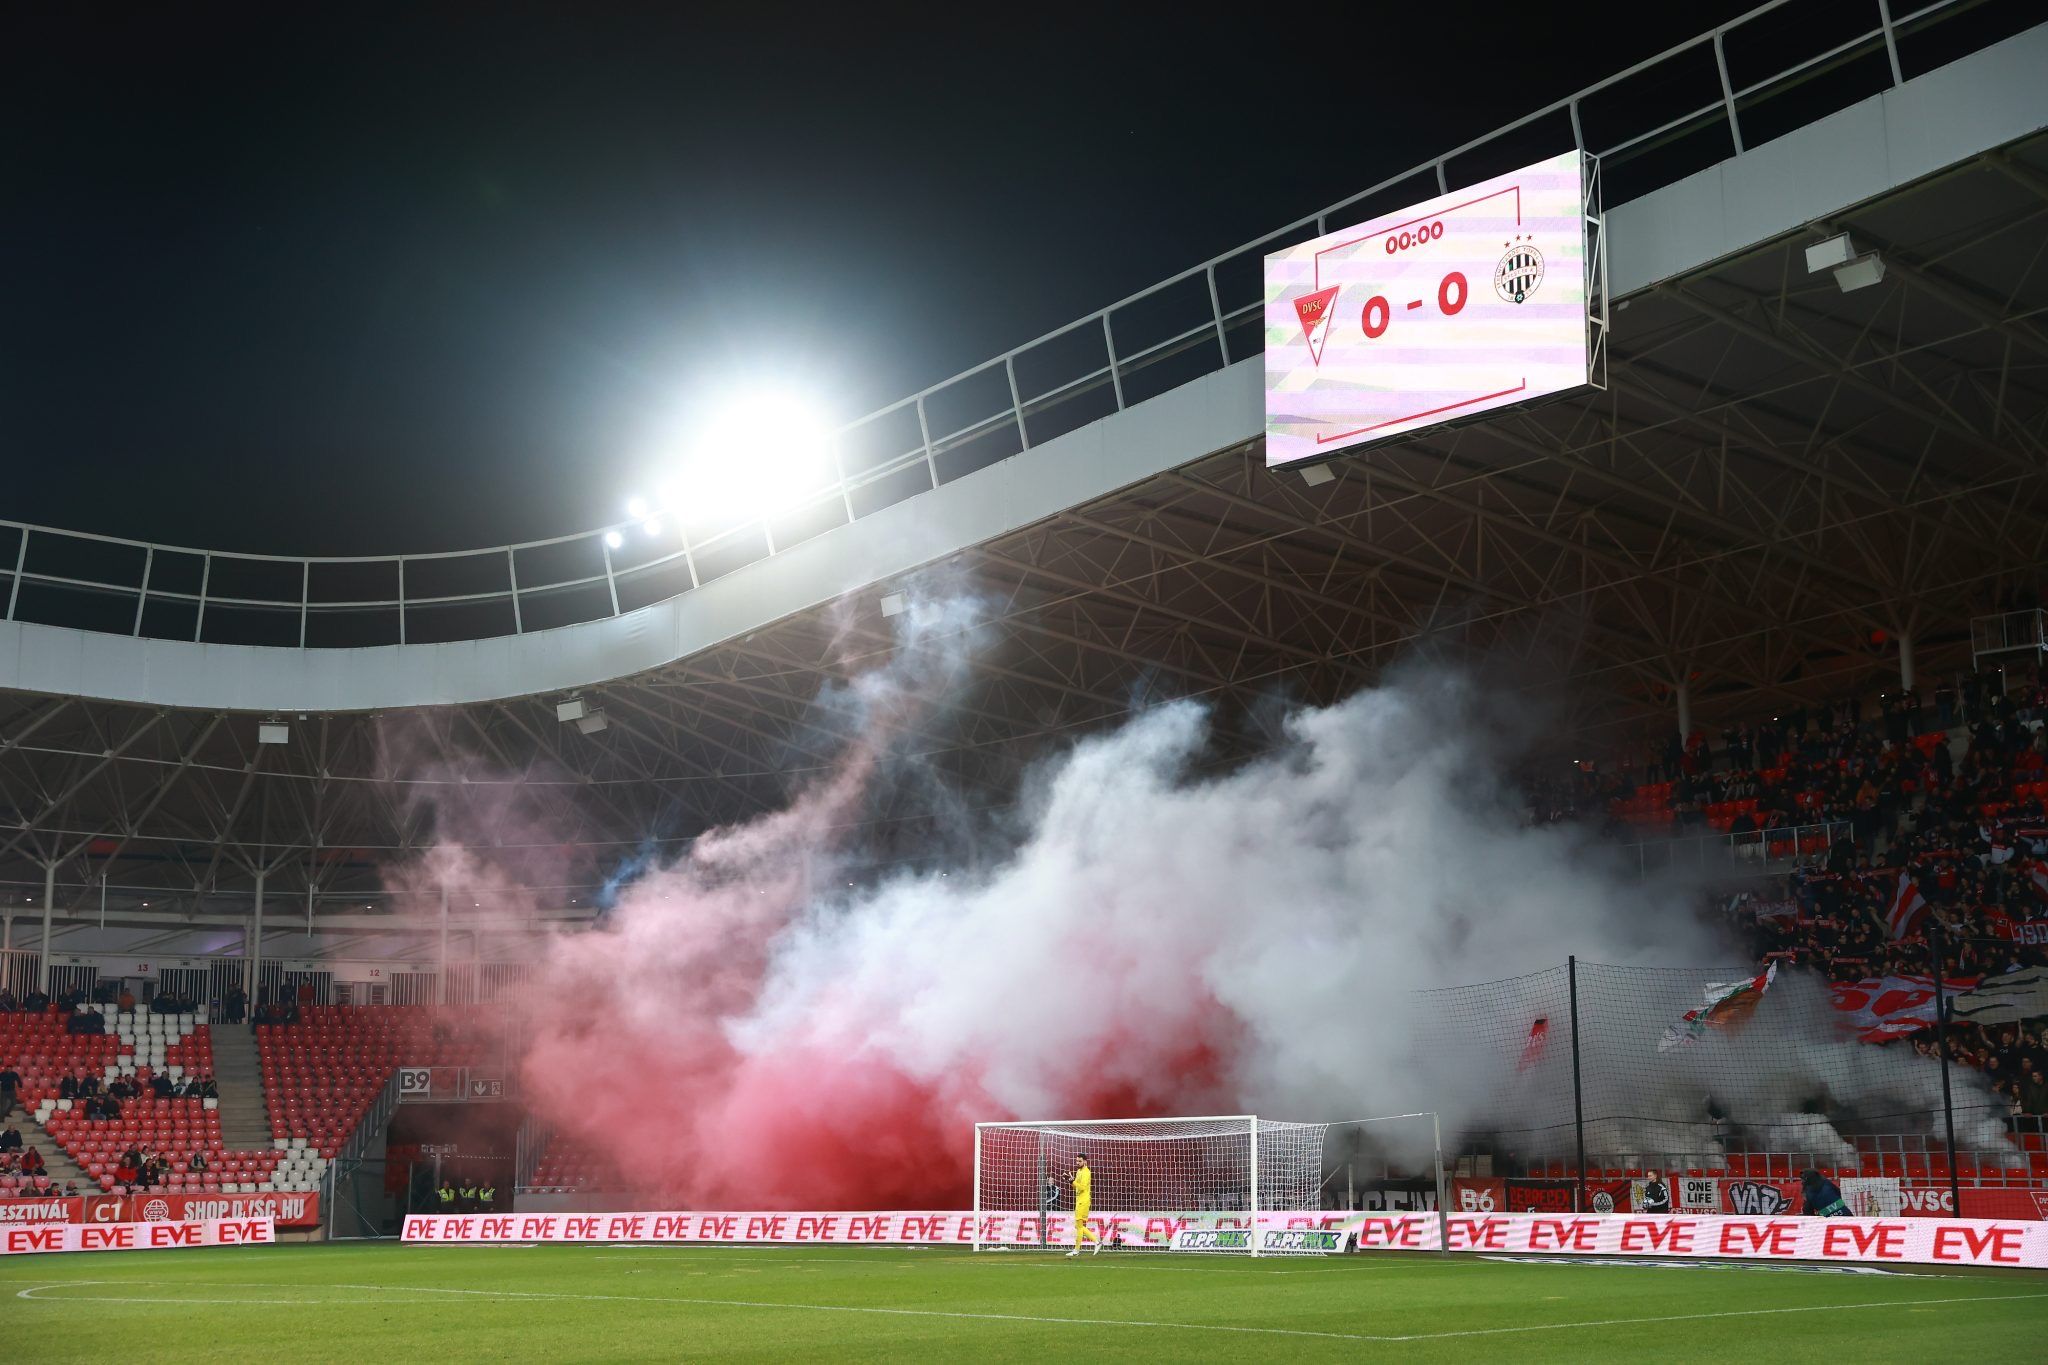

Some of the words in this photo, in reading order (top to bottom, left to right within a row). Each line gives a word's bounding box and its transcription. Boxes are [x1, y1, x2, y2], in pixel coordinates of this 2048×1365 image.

[1386, 221, 1443, 254] 00:00
[1302, 299, 1322, 314] DVSC
[1362, 296, 1390, 338] 0
[1407, 299, 1423, 311] -
[1438, 271, 1468, 316] 0
[138, 964, 149, 972] 13
[370, 969, 380, 977] 12
[400, 1071, 430, 1090] B9
[1687, 1182, 1712, 1192] ONE
[1461, 1188, 1494, 1212] B6
[1687, 1193, 1712, 1203] LIFE
[95, 1203, 122, 1221] C1
[7, 1228, 64, 1252] EVE
[80, 1226, 134, 1249] EVE
[150, 1223, 202, 1247] EVE
[217, 1221, 267, 1243] EVE
[406, 1218, 436, 1240] EVE
[443, 1217, 474, 1240] EVE
[480, 1217, 514, 1240] EVE
[521, 1217, 556, 1240] EVE
[564, 1217, 601, 1240] EVE
[608, 1216, 645, 1240] EVE
[653, 1216, 690, 1239] EVE
[698, 1216, 737, 1239] EVE
[746, 1216, 786, 1240] EVE
[796, 1216, 838, 1240] EVE
[848, 1216, 890, 1240] EVE
[901, 1216, 946, 1241] EVE
[1361, 1215, 1424, 1246] EVE
[1446, 1218, 1509, 1248] EVE
[1528, 1218, 1600, 1250] EVE
[1620, 1219, 1697, 1253] EVE
[1719, 1220, 1799, 1255] EVE
[1822, 1222, 1907, 1258] EVE
[1933, 1225, 2024, 1263] EVE
